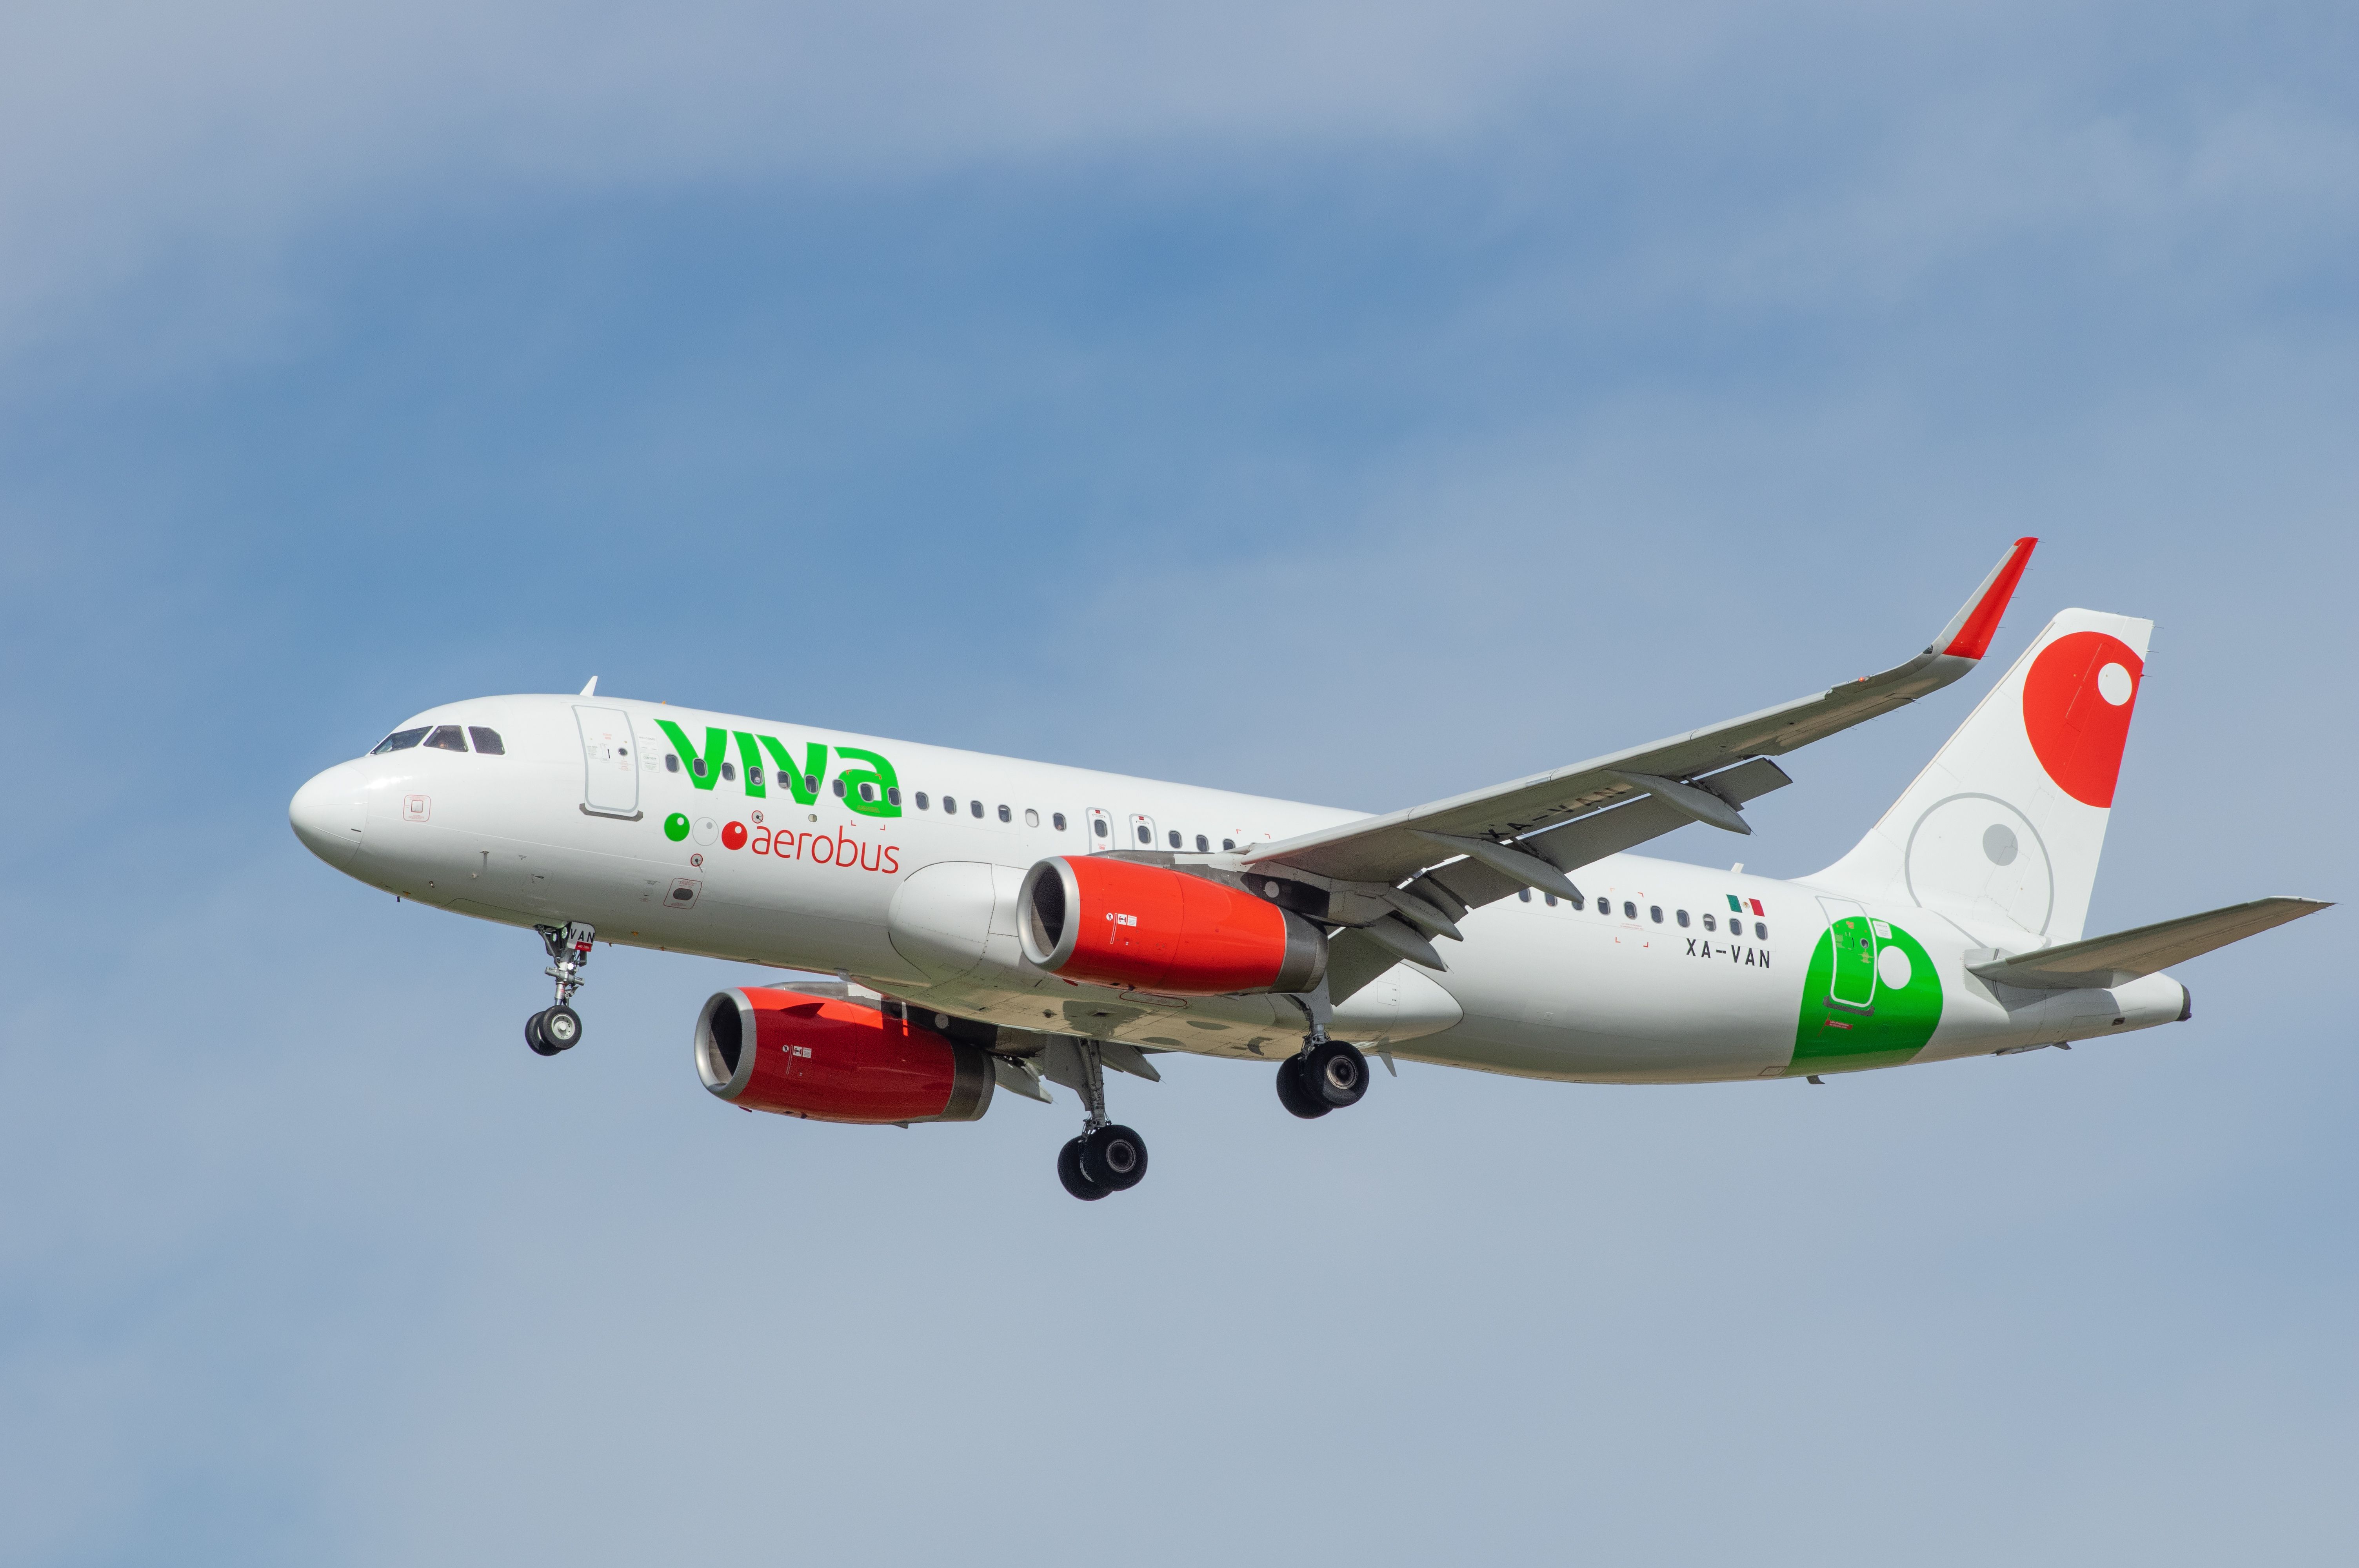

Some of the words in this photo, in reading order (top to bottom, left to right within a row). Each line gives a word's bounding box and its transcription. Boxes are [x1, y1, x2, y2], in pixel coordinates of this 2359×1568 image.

[752, 825, 900, 874] aerobus
[571, 928, 595, 943] VAN
[1686, 938, 1770, 969] XA-VAN
